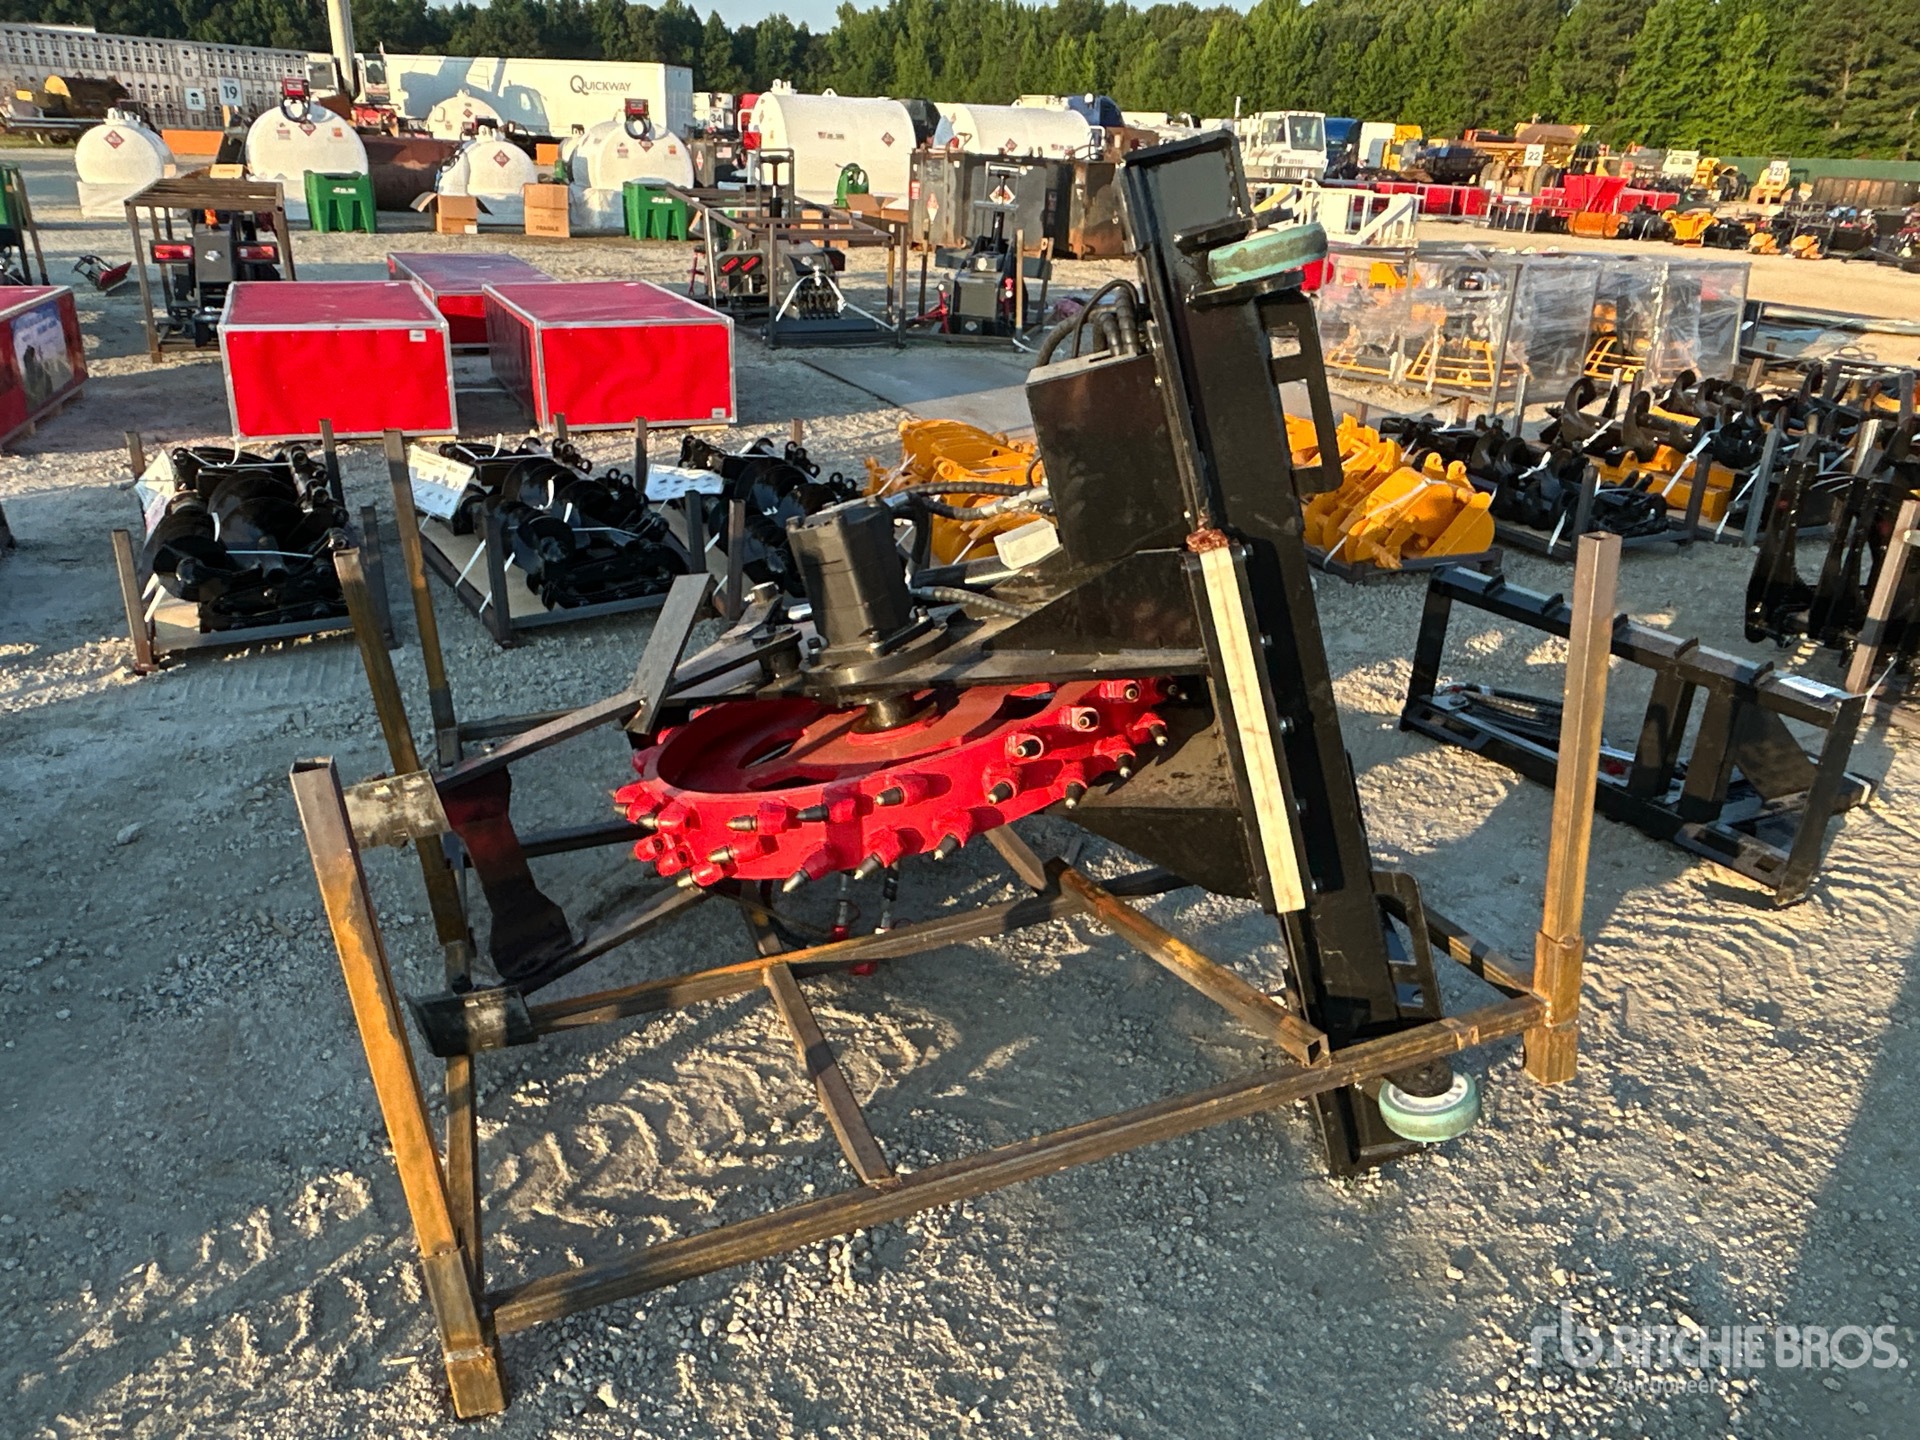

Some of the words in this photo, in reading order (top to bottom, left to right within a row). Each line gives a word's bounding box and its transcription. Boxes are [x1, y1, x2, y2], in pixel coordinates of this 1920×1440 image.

[570, 75, 631, 96] QUICKWAY
[223, 86, 238, 99] 19
[711, 114, 722, 123] 34
[1528, 152, 1541, 161] 22
